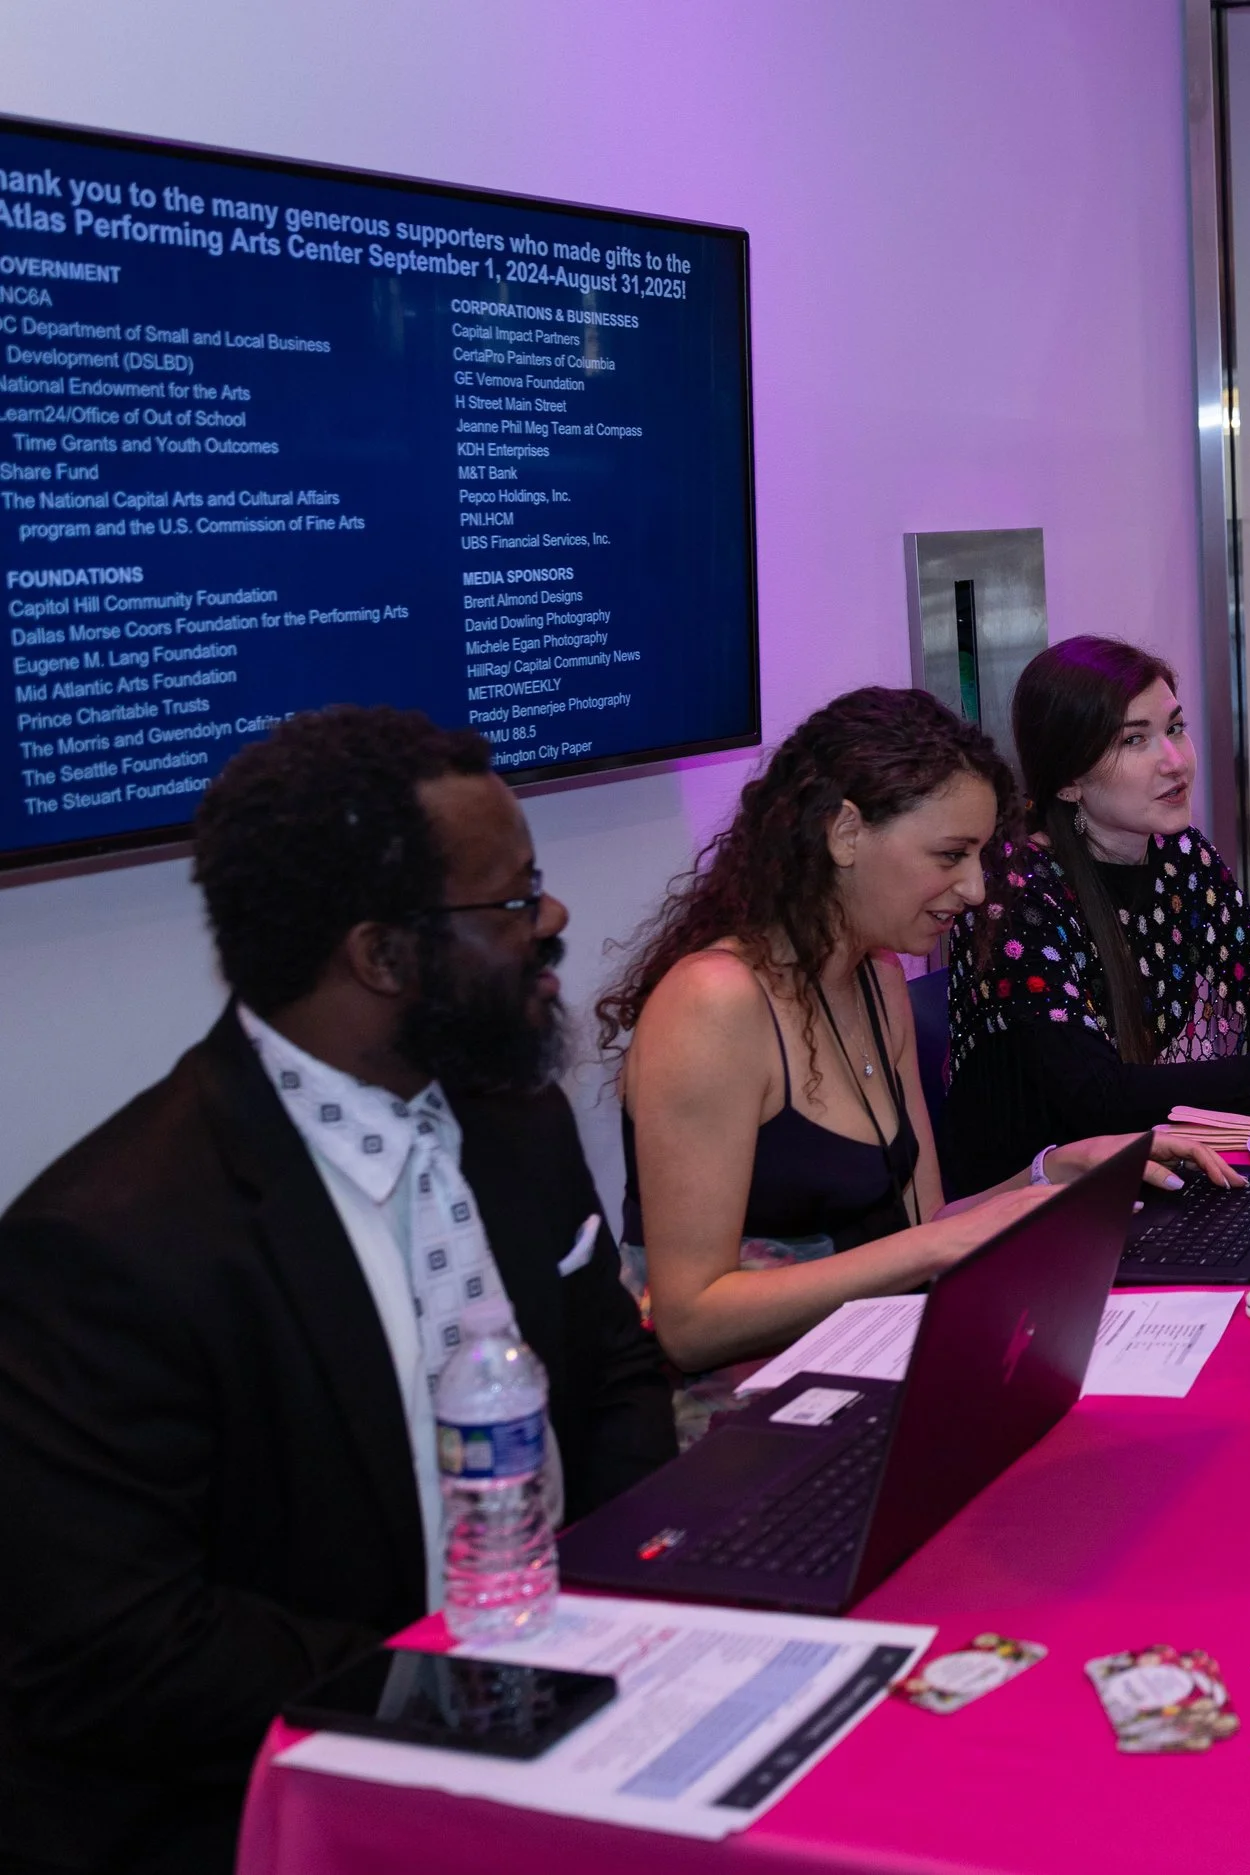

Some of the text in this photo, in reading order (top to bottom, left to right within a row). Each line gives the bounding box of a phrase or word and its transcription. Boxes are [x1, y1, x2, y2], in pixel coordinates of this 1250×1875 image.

[70, 177, 120, 208] you
[129, 179, 155, 209] to
[163, 184, 203, 215] the
[212, 196, 277, 229] many
[285, 206, 389, 238] generous
[396, 221, 503, 252] supporters
[509, 232, 547, 258] who
[554, 240, 599, 264] made
[606, 245, 640, 271] gifts
[646, 249, 661, 272] to
[666, 252, 692, 275] the
[75, 208, 222, 257] Performing
[231, 226, 279, 257] Arts
[288, 233, 362, 266] Center
[369, 243, 478, 278] September
[485, 256, 500, 284] 1,
[506, 259, 616, 295] 2024-August
[451, 299, 639, 329] CORPORATIONS & BUSINESSES
[22, 319, 120, 341] Department
[125, 326, 140, 342] of
[145, 327, 188, 345] Small
[193, 331, 220, 346] and
[225, 332, 263, 349] Local
[268, 335, 331, 353] Business
[452, 323, 580, 347] Capital Impact Partners
[6, 345, 194, 374] Development (DSLBD)
[453, 348, 615, 372] CertaPro Painters of Columbia
[69, 379, 164, 399] Endowment
[168, 383, 189, 399] for
[193, 384, 216, 400] the
[221, 385, 251, 401] Arts
[454, 371, 585, 392] GE Vernova Foundation
[455, 394, 567, 414] H Street Main Street
[124, 409, 138, 425] of
[143, 409, 172, 426] Out
[176, 410, 191, 427] of
[195, 410, 246, 428] School
[456, 418, 643, 440] Jeanne Phil Meg Team at Compass
[13, 433, 279, 454] Time Grants and Youth Outcomes
[457, 443, 550, 461] KDH Enterprises
[0, 463, 99, 481] Share Fund
[458, 467, 518, 480] M&T Bank
[2, 490, 341, 513] The National Capital Arts and Cultural Affairs
[459, 489, 571, 507] Pepco Holdings, Inc.
[19, 515, 365, 540] program and the U.S. Commission of Fine Arts
[461, 532, 611, 550] UBS Financial Services, Inc.
[7, 566, 143, 589] FOUNDATIONS
[463, 567, 574, 586] MEDIA SPONSORS
[9, 587, 277, 621] Capitol Hill Community Foundation
[464, 589, 583, 610] Brent Almond Designs
[11, 604, 409, 647] Dallas Morse Coors Foundation for the Performing Arts
[465, 607, 611, 633] David Dowling Photography
[466, 630, 608, 655] Michele Egan Photography
[14, 641, 237, 678] Eugene M. Lang Foundation
[514, 657, 550, 676] Capital
[554, 652, 610, 670] Community
[614, 650, 641, 664] News
[16, 667, 237, 703] Mid Atlantic Arts Foundation
[468, 678, 561, 702] METROWEEKLY
[17, 696, 209, 732] Prince Charitable Trusts
[469, 691, 631, 725] Praddy Bennerjee Photography
[20, 740, 52, 760] The
[58, 733, 109, 755] Morris
[114, 728, 143, 748] and
[148, 720, 231, 744] Gwendolyn
[478, 725, 537, 746] AMU 88.5
[490, 740, 593, 765] shington City Paper
[22, 749, 208, 788] The Seattle Foundation
[25, 775, 211, 816] The Steuart Foundation
